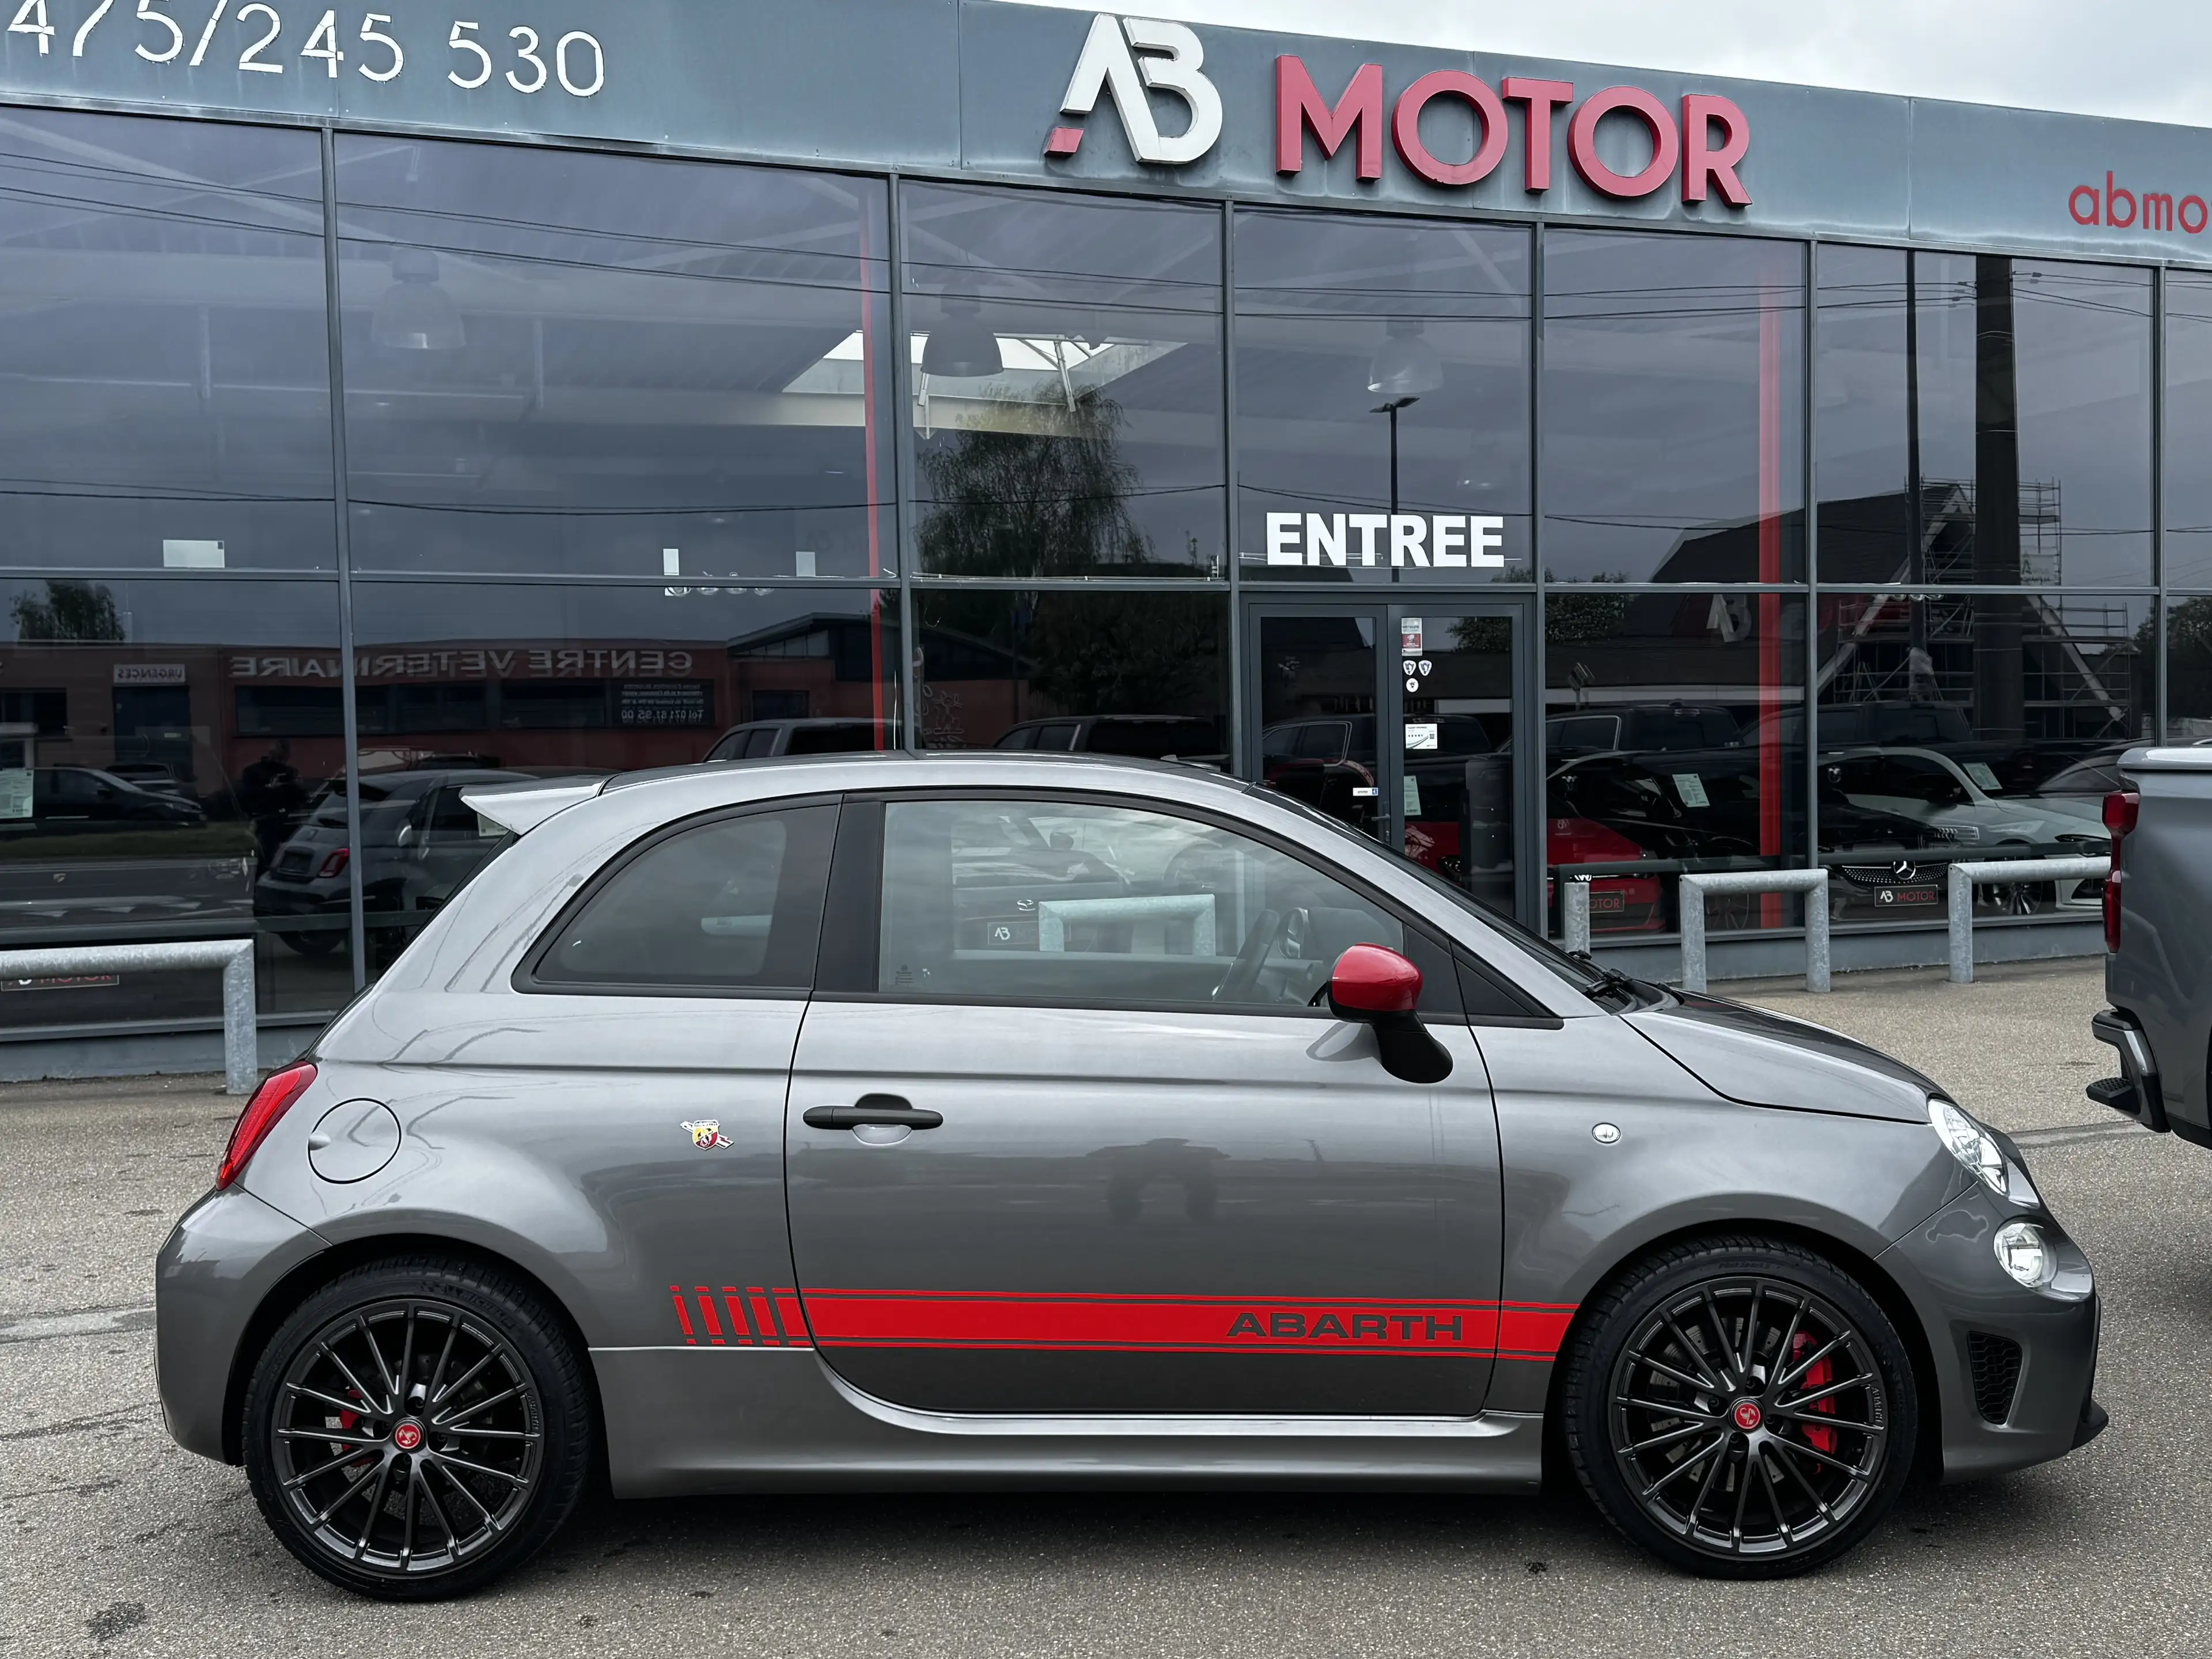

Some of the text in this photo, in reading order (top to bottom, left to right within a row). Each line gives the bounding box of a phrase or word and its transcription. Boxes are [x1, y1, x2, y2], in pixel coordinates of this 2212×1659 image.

[448, 21, 605, 97] 530
[1044, 13, 1753, 208] AB MOTOR
[2069, 171, 2212, 234] abmo
[1267, 512, 1505, 567] ENTREE
[1589, 897, 1620, 909] OTOR
[1897, 891, 1936, 903] MOTOR
[1226, 1312, 1463, 1341] ABARTH
